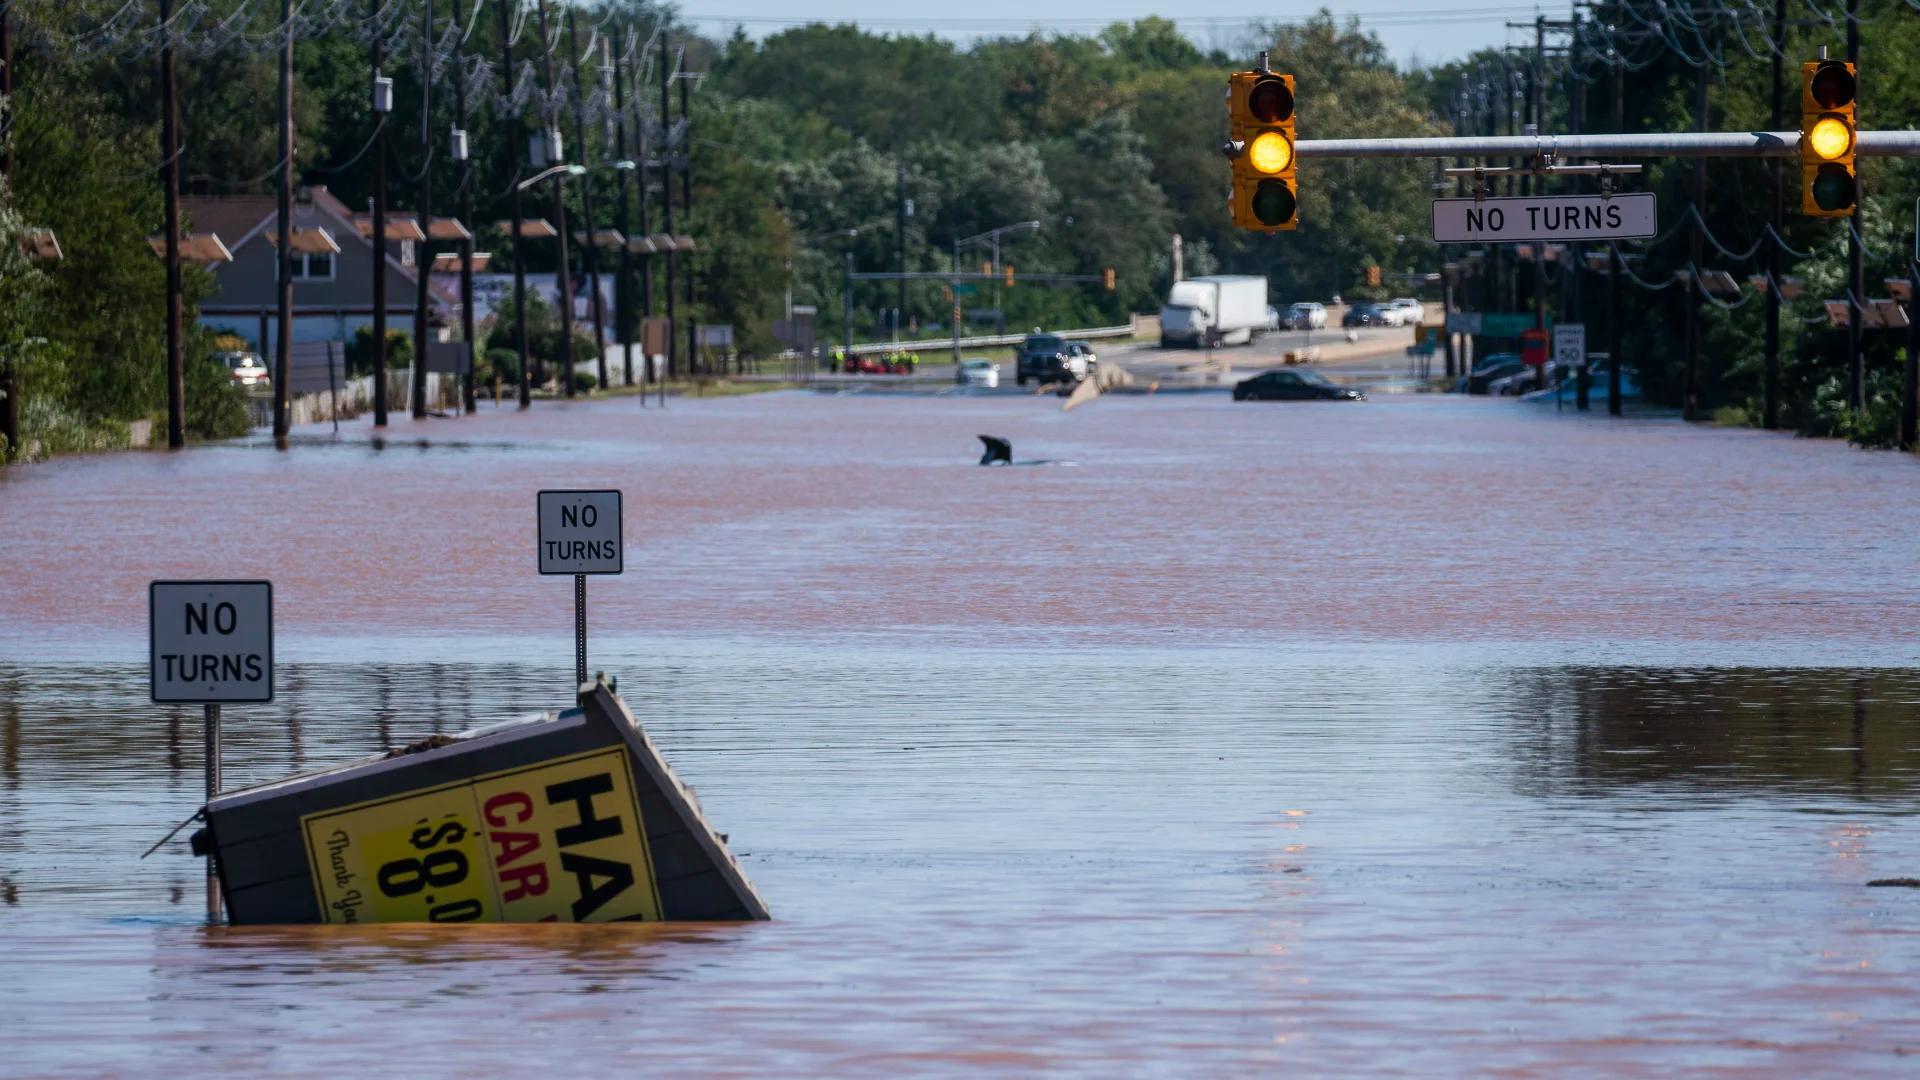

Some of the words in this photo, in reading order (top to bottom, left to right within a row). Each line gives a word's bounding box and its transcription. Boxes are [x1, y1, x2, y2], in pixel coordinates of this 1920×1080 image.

[1466, 207, 1504, 232] NO
[1526, 204, 1622, 231] TURNS
[1559, 347, 1580, 361] 50
[561, 504, 597, 528] NO
[545, 539, 616, 560] TURNS
[185, 601, 237, 635] NO
[161, 653, 263, 682] TURNS
[326, 829, 356, 889] Thank
[483, 791, 549, 904] CAR
[545, 772, 643, 922] HA
